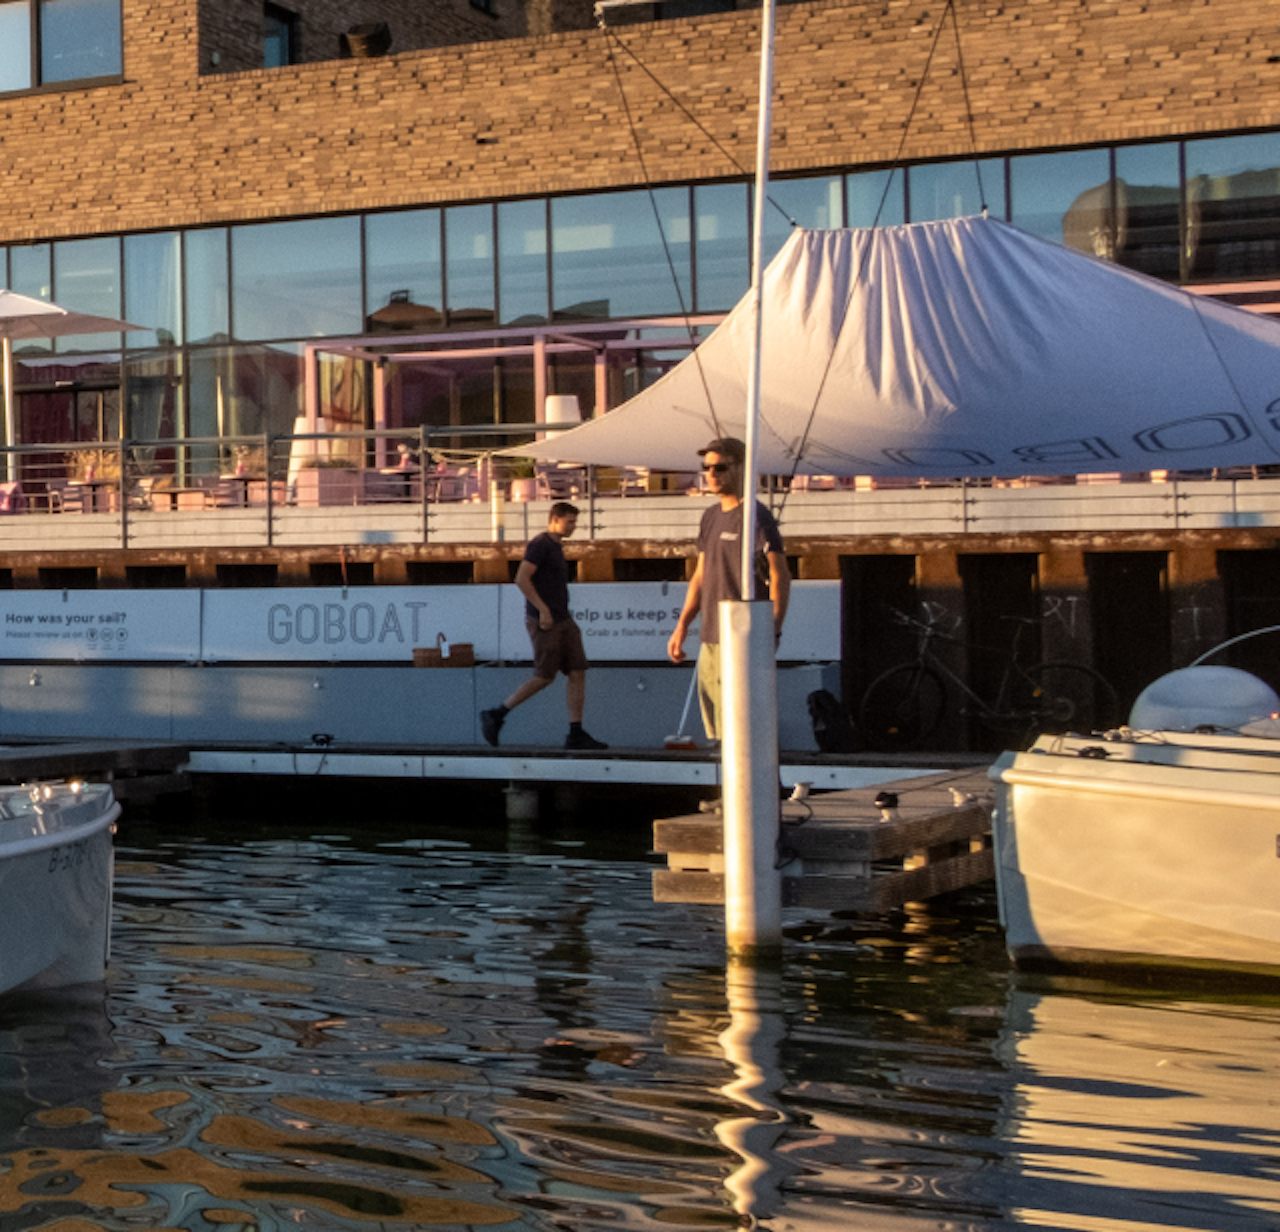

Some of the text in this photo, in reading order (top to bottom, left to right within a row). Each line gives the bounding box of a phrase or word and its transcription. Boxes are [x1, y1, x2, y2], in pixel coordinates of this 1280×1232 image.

[5, 611, 127, 626] How was your sail?
[571, 608, 600, 622] elp
[603, 610, 623, 620] us
[627, 608, 667, 622] keep
[268, 602, 427, 645] GOBOAT
